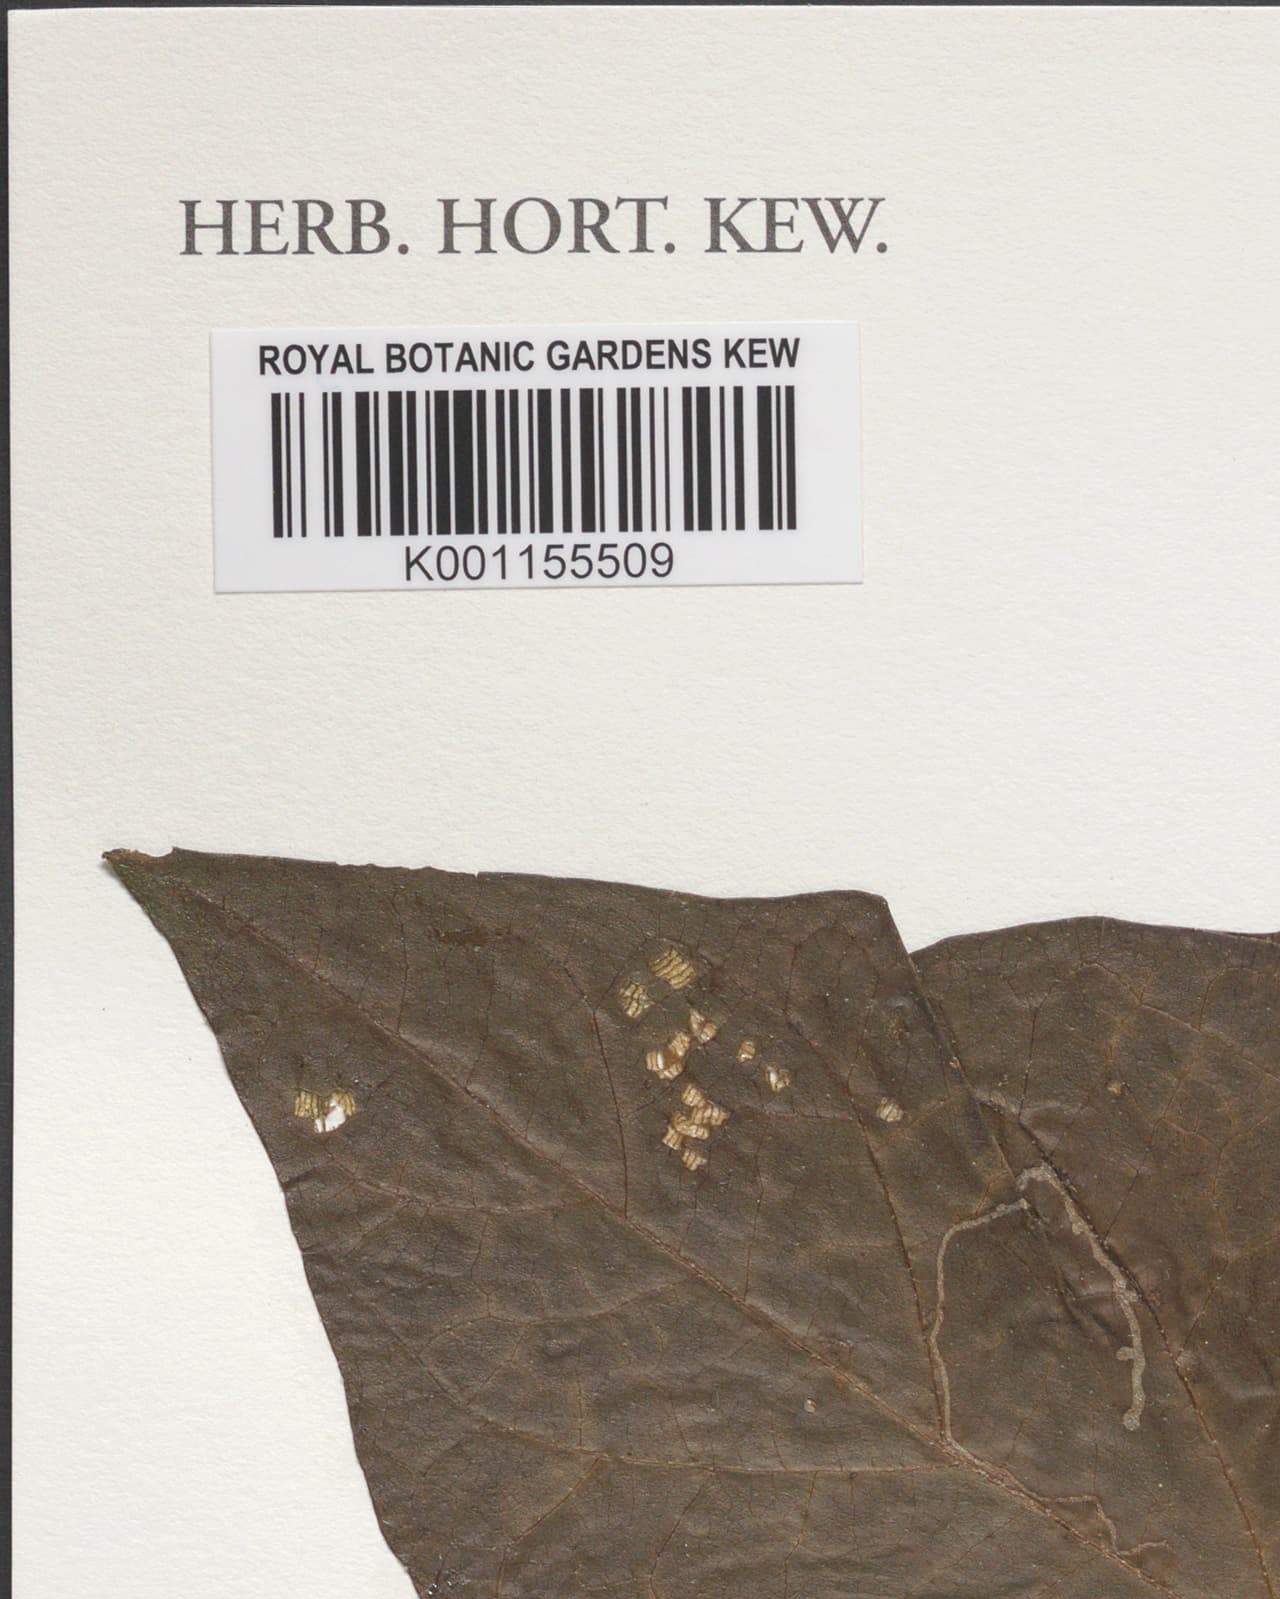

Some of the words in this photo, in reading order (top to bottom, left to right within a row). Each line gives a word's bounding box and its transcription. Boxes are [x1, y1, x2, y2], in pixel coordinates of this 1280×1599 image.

[178, 198, 409, 256] HERB.
[436, 195, 676, 255] HORT.
[703, 197, 888, 254] KEW.
[259, 343, 375, 376] ROYAL
[385, 340, 535, 374] BOTANIC
[546, 338, 712, 372] GARDENS
[724, 337, 801, 369] KEW
[405, 542, 674, 582] K001155509
